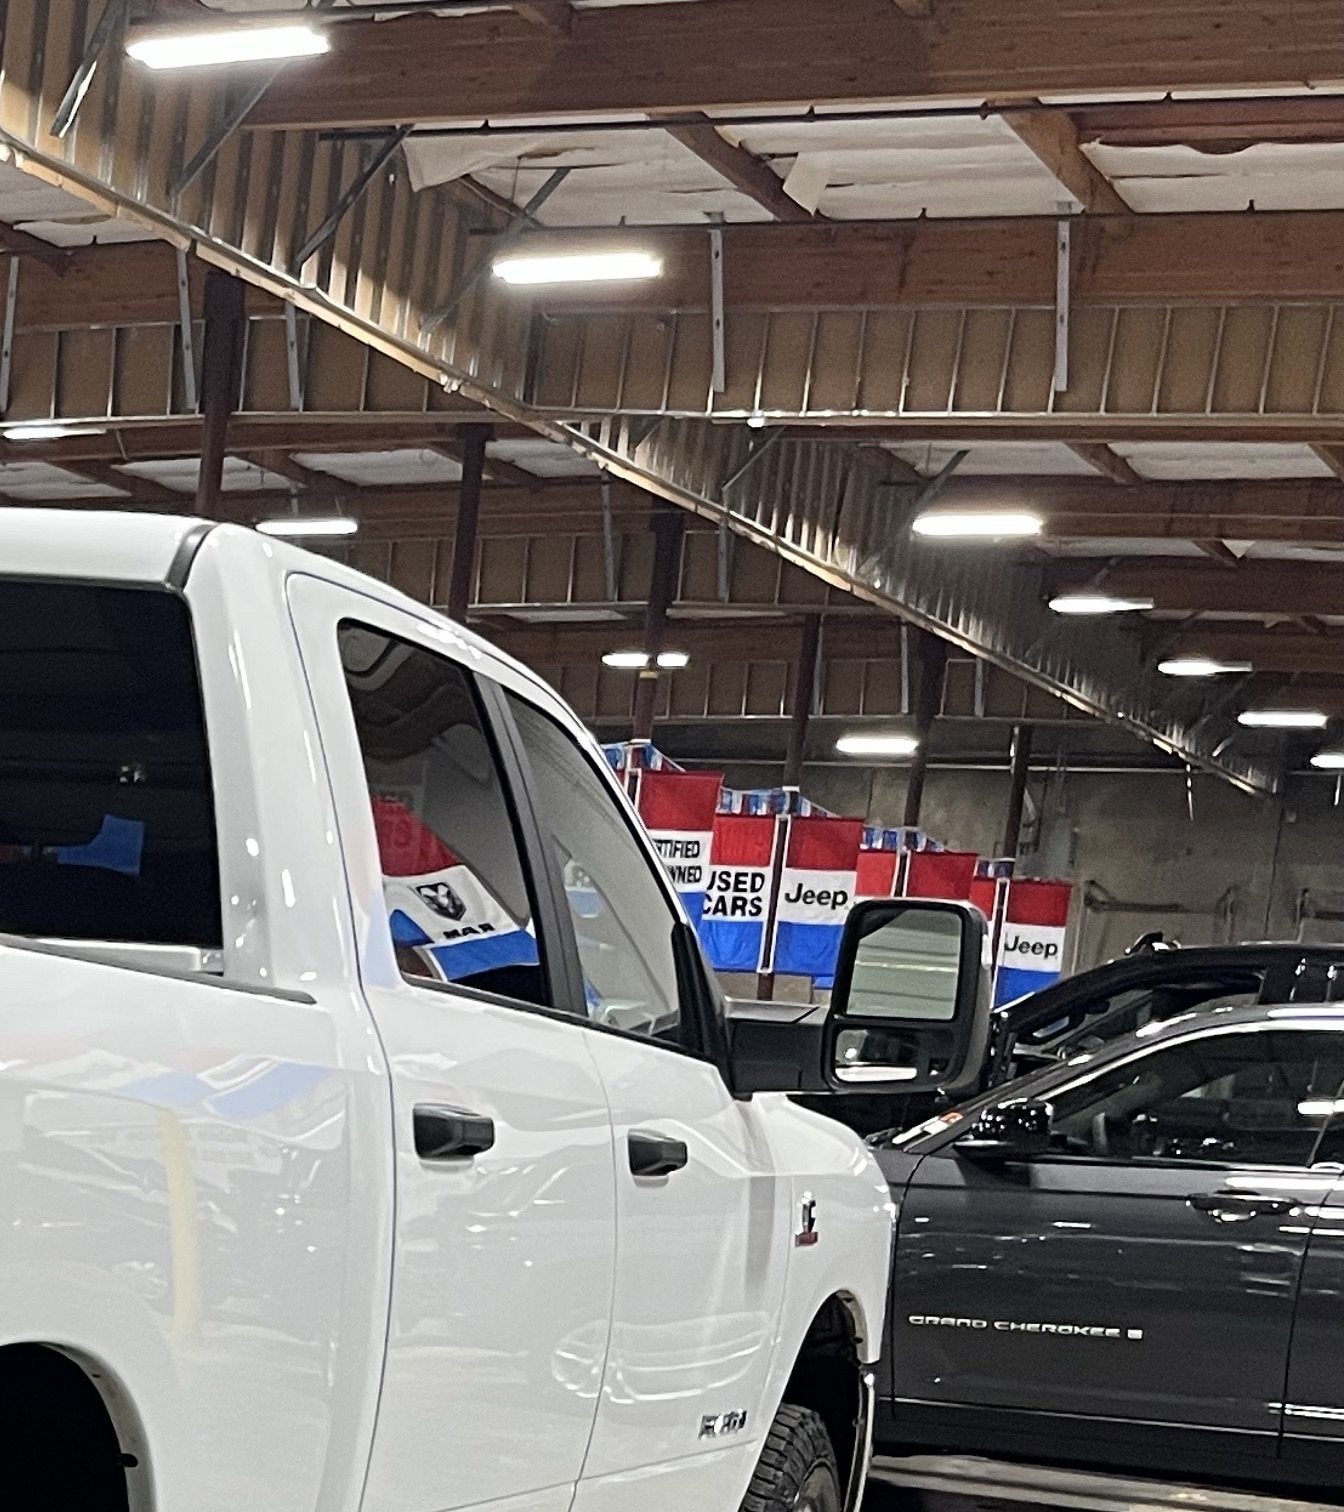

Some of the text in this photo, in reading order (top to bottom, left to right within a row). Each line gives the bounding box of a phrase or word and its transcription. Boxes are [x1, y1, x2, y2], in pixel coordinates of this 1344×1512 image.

[784, 882, 849, 910] Jeep
[1003, 935, 1058, 960] Jeep
[908, 1314, 988, 1329] GRAND
[993, 1320, 1121, 1338] CHEROKEE
